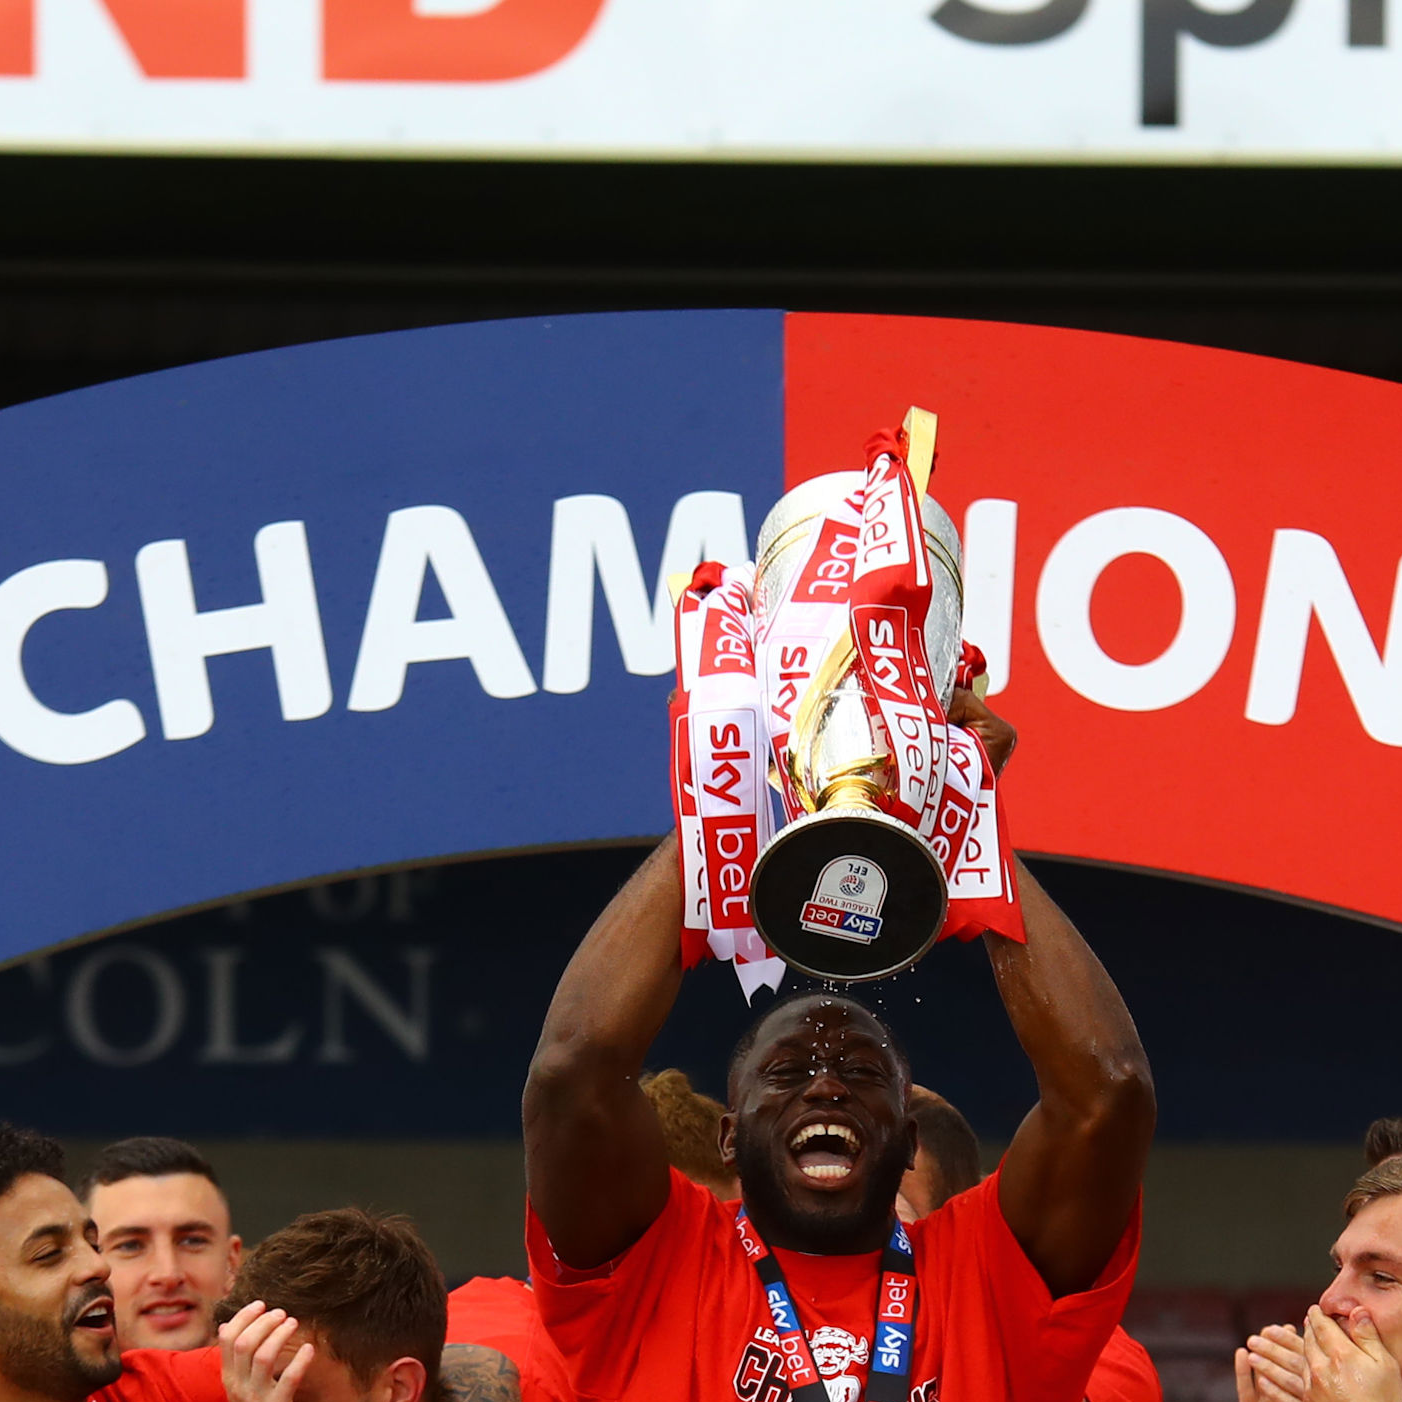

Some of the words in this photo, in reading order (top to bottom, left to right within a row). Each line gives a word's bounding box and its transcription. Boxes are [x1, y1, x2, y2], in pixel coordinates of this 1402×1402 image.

[772, 646, 811, 723] sky
[869, 619, 908, 699] sky
[895, 712, 925, 798] bet
[703, 723, 750, 806] sky
[716, 827, 752, 917] bet
[848, 863, 868, 876] EFL
[807, 908, 840, 927] bet
[844, 914, 875, 933] sky
[882, 1278, 909, 1318] bet
[781, 1336, 812, 1382] bet
[877, 1325, 908, 1368] sky
